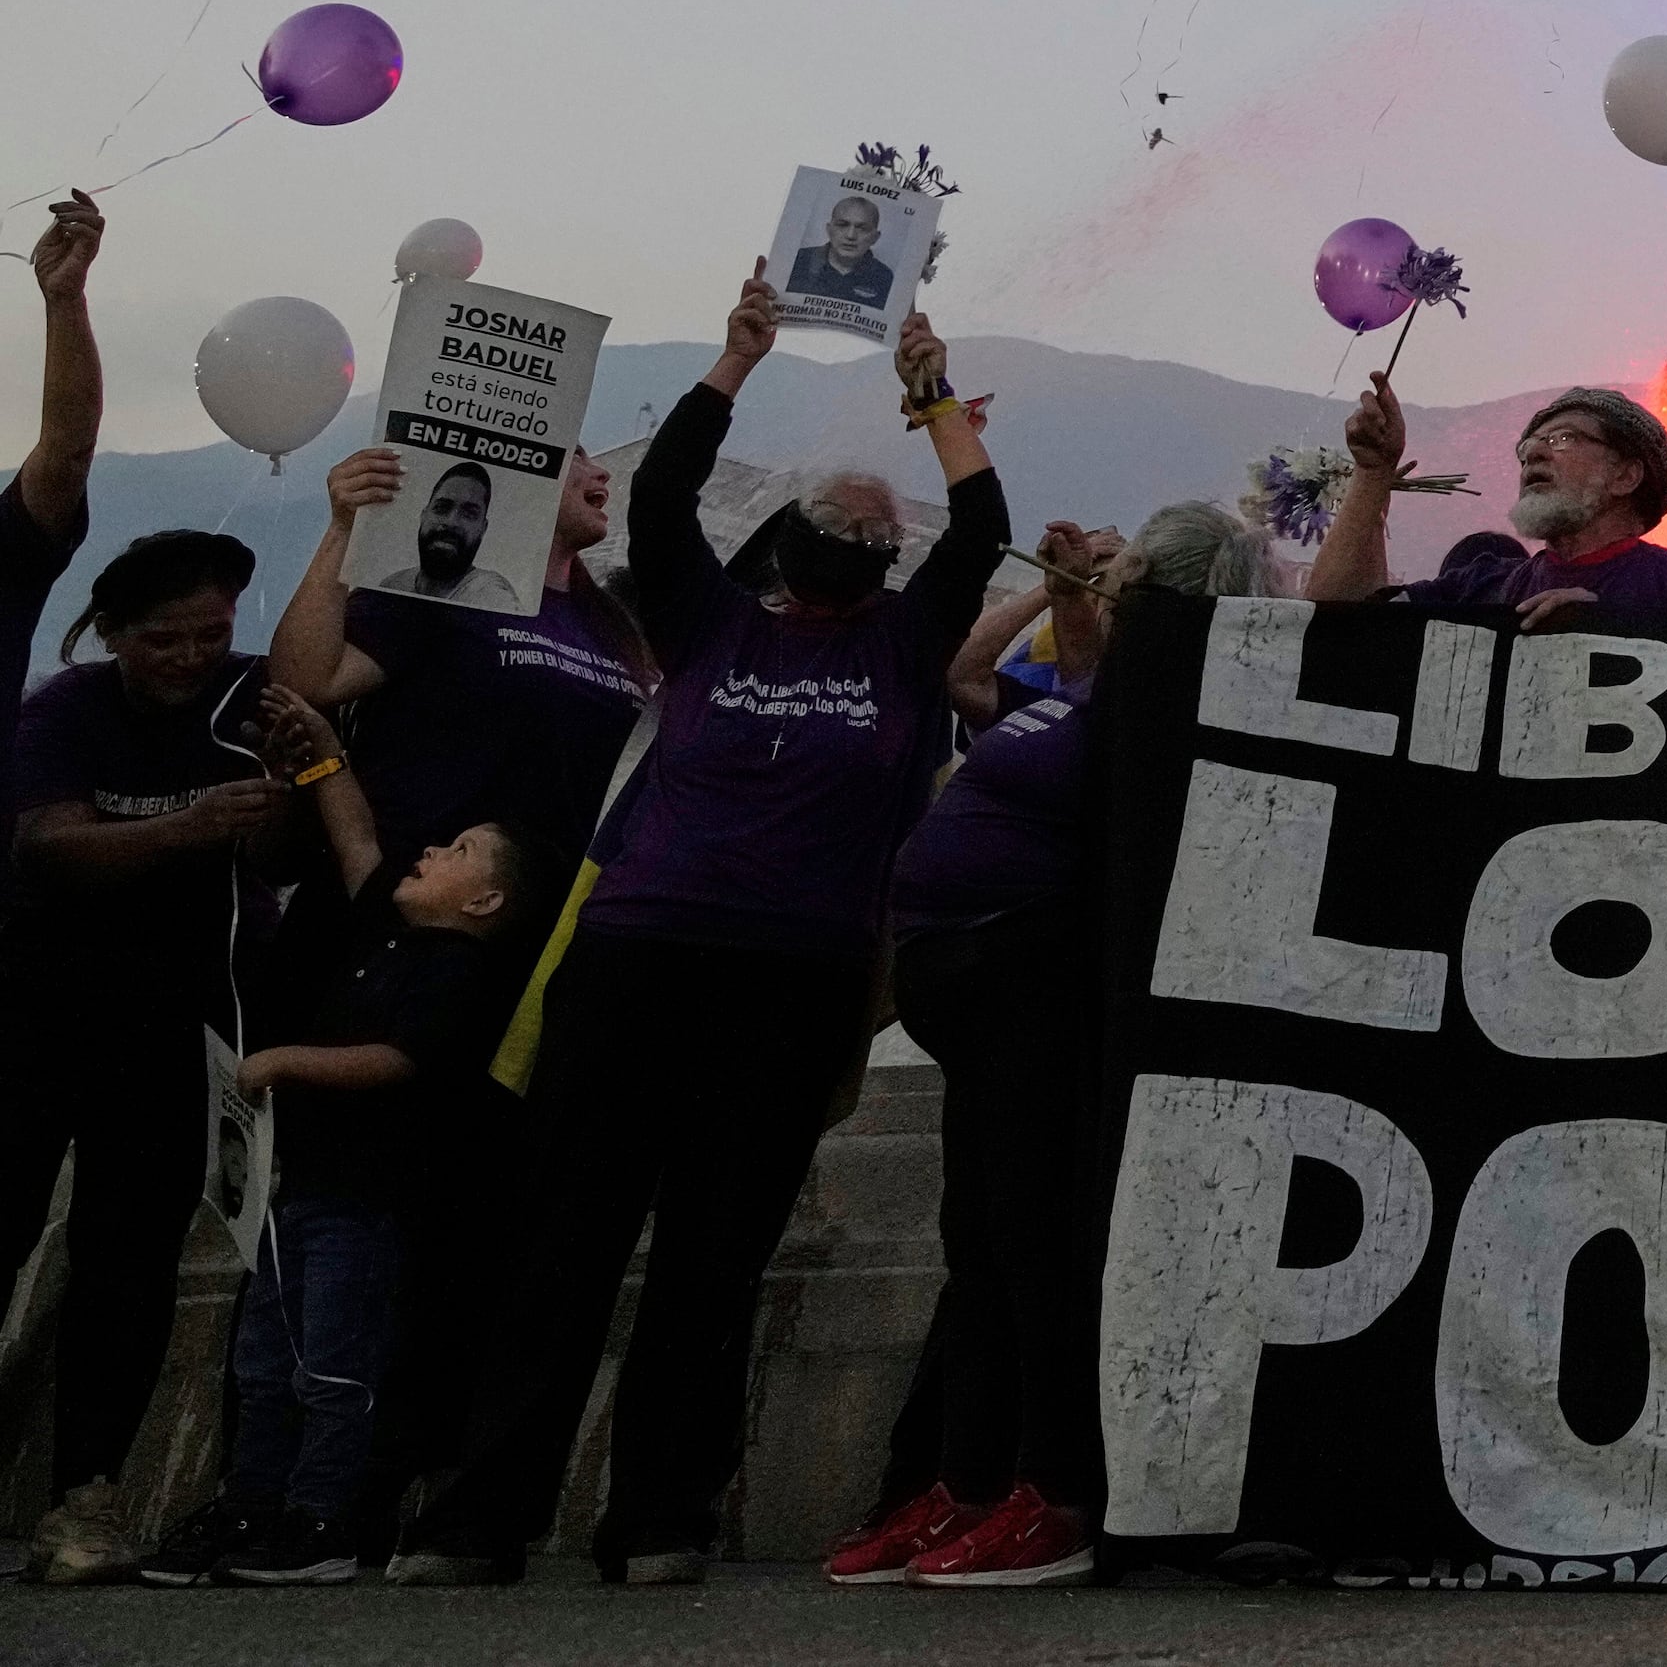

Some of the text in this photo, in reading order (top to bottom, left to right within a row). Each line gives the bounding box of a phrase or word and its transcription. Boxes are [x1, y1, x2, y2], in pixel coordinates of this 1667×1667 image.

[840, 178, 901, 201] LUIS LOPEZ
[772, 303, 824, 316] INFORMAR
[824, 309, 839, 319] NO
[841, 314, 852, 322] ES
[854, 315, 888, 332] DELITO
[804, 296, 861, 313] PERIODISTA
[445, 303, 567, 350] JOSNAR
[440, 335, 557, 383] BADUEL
[431, 368, 549, 410] está siendo
[424, 389, 549, 436] torturado
[407, 421, 549, 470] EN EL RODEO
[499, 650, 508, 666] Y
[509, 650, 545, 666] PONER
[826, 676, 842, 696] LOS
[744, 695, 757, 713] EN
[757, 700, 807, 717] LIBERTAD
[815, 696, 834, 714] LOS
[847, 718, 871, 728] LUCAS
